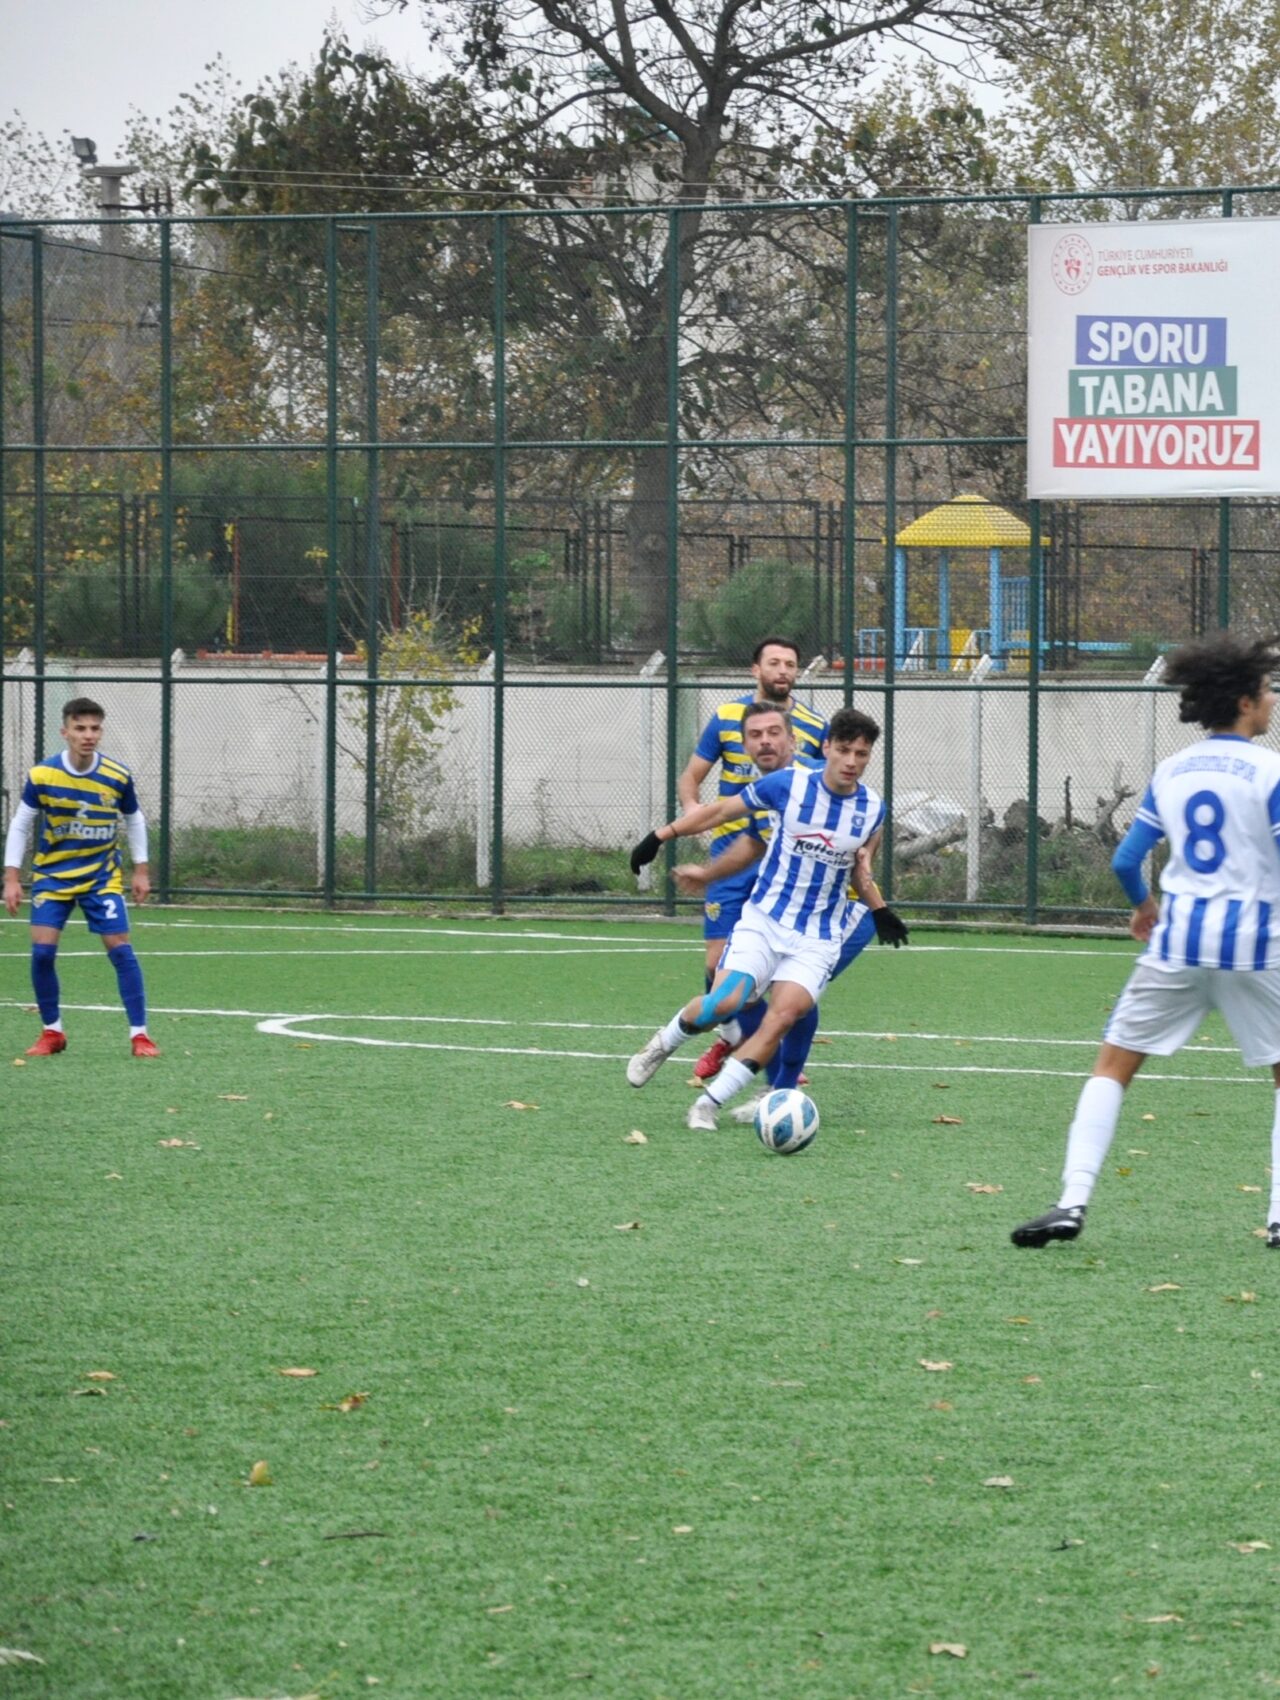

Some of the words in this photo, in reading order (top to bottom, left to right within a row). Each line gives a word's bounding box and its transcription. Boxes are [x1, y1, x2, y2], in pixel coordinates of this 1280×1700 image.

[1097, 263, 1136, 277] GENÇLİK
[1138, 264, 1150, 275] VE
[1152, 263, 1176, 274] SPOR
[1178, 259, 1228, 273] BAKANLIĞI
[1098, 248, 1132, 261] TÜRKİYE
[1088, 321, 1207, 365] SPORU
[1078, 371, 1224, 416] TABANA
[1058, 424, 1255, 466] YAYIYORUZ
[1184, 789, 1226, 875] 8
[103, 899, 118, 919] 2
